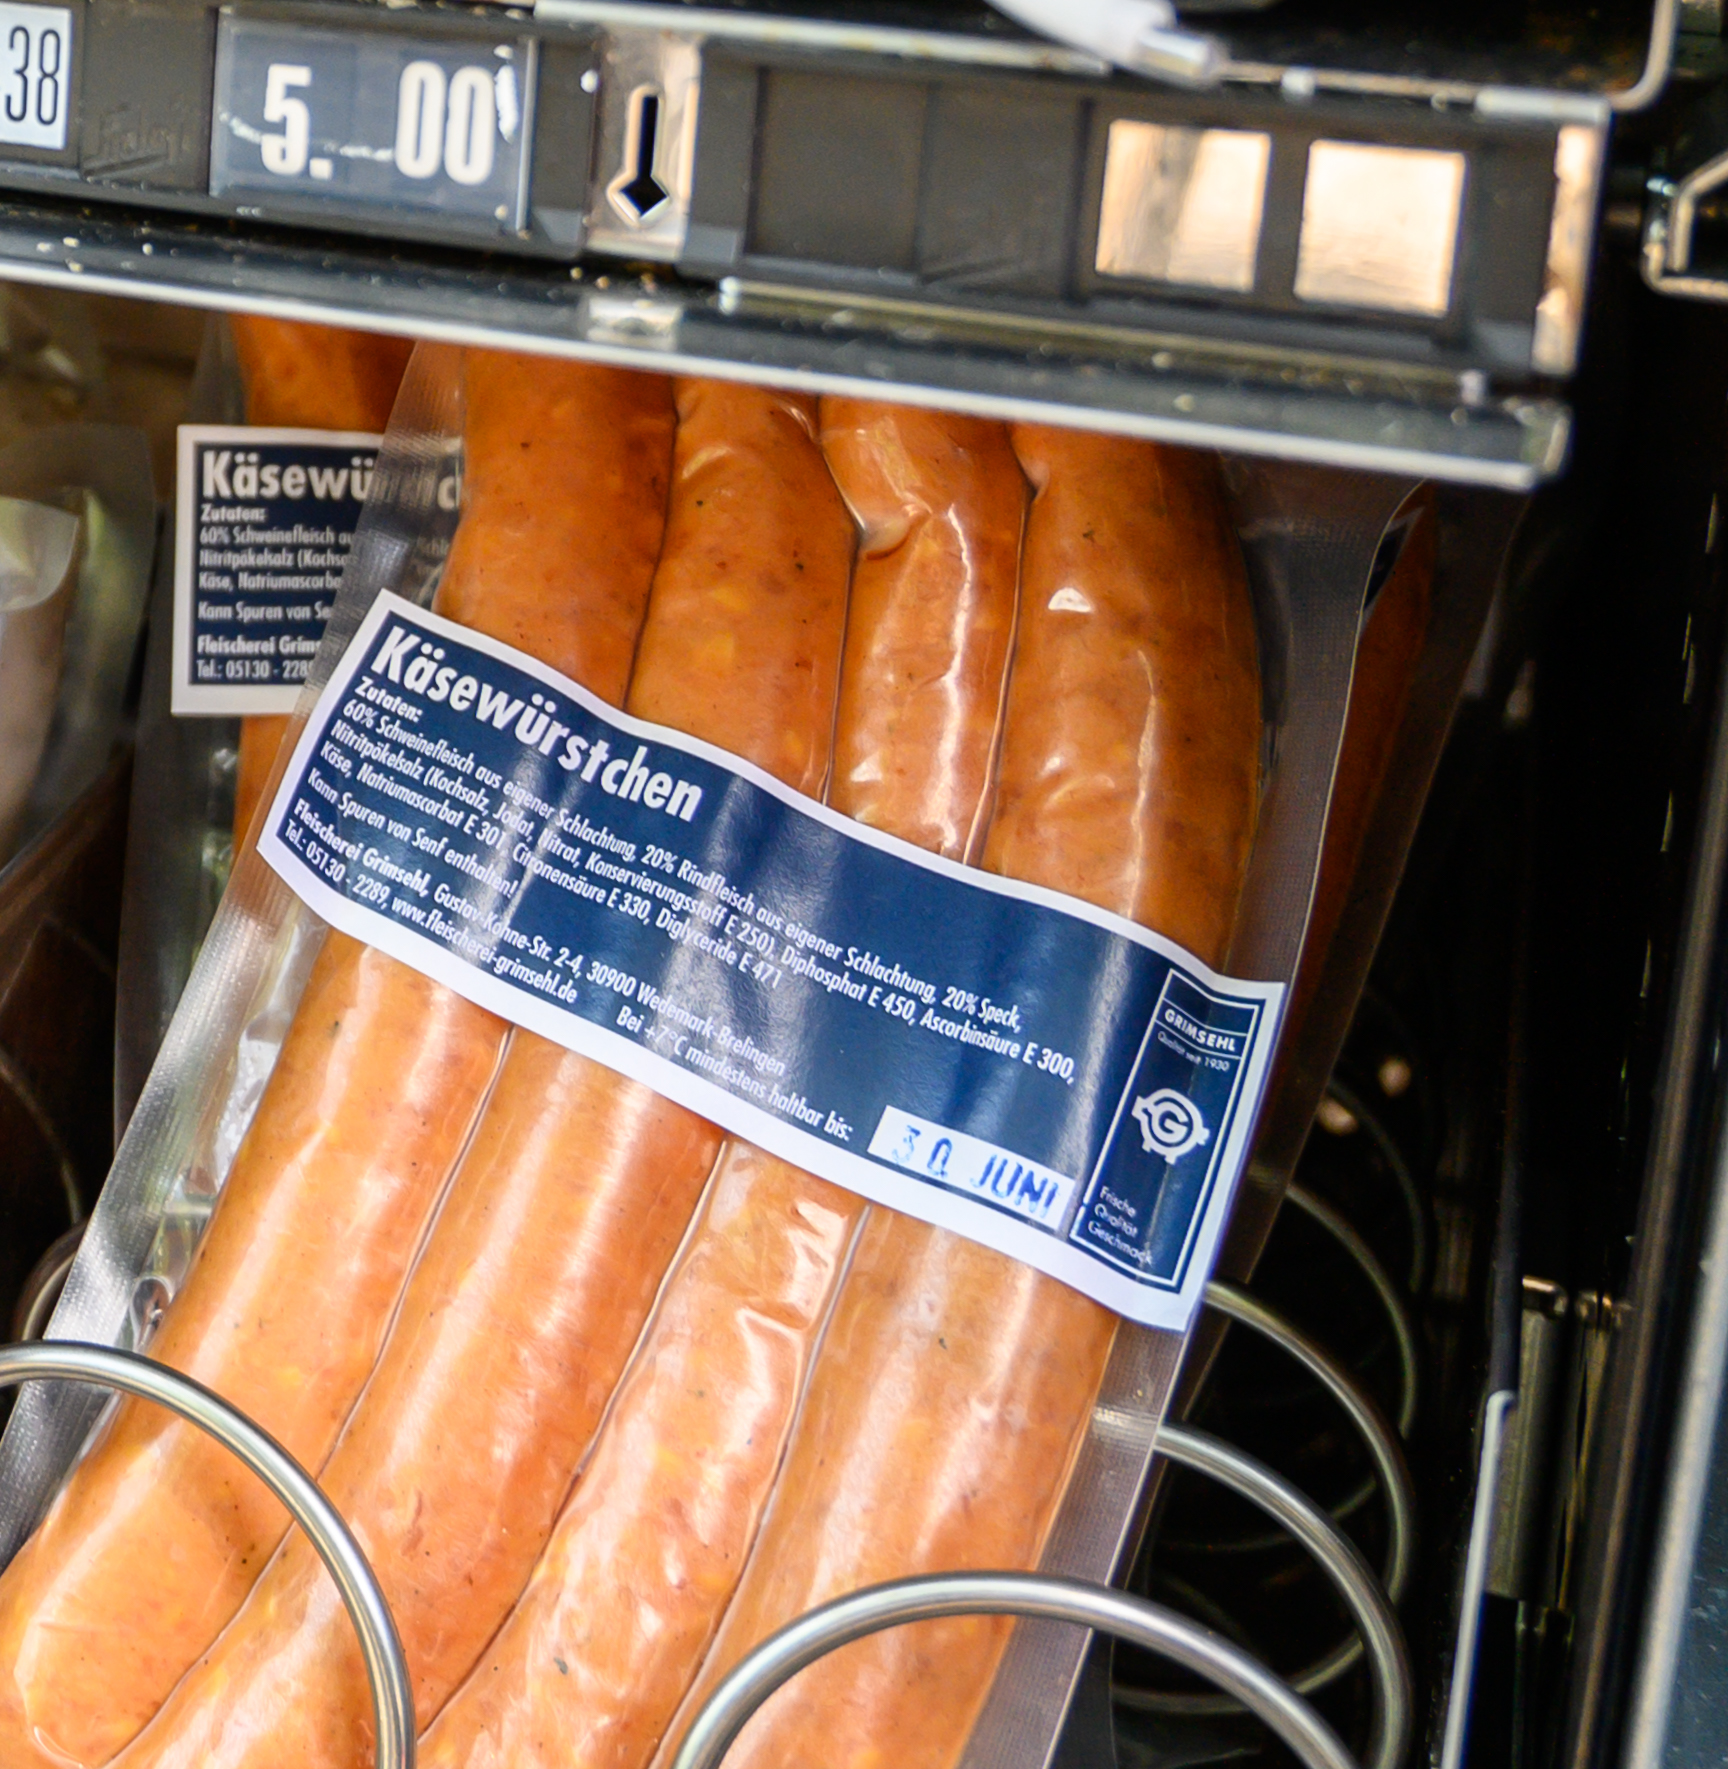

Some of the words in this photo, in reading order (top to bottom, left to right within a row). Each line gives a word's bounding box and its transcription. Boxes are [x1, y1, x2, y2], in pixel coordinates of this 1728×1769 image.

[394, 60, 497, 186] 00
[197, 635, 275, 654] Fleischerei
[225, 660, 269, 678] 05130
[354, 675, 423, 723] Zutaten:
[371, 625, 703, 822] Käsewürstchen
[306, 768, 337, 804] Kann
[341, 792, 394, 830] Spuren
[387, 815, 412, 842] von
[412, 827, 450, 860] Senf
[320, 741, 353, 778] Käse,
[357, 763, 465, 827] Natriumascorbat
[512, 842, 605, 904] Citronensäure
[606, 887, 621, 908] E
[618, 892, 651, 926] 330,
[655, 908, 736, 966] Diglyceride
[738, 953, 753, 973] E
[751, 960, 783, 989] 471
[331, 719, 425, 780] Nitritpökelsalz
[423, 765, 490, 816] (Kochsalz,
[493, 801, 535, 841] Jodat,
[584, 852, 726, 925] Konservierungsstoff
[781, 945, 867, 1002] Diphosphat
[868, 987, 882, 1007] E
[882, 994, 916, 1027] 450,
[920, 1009, 1021, 1058] Ascorbinsäure
[1023, 1042, 1038, 1064] E
[1036, 1048, 1075, 1084] 300,
[342, 698, 377, 728] 60%
[376, 713, 474, 775] Schweinefleisch
[475, 766, 503, 788] aus
[503, 782, 556, 820] eigener
[556, 808, 637, 862] Schlachtung,
[641, 844, 678, 874] 20%
[677, 860, 756, 916] Rindfleisch
[756, 907, 785, 932] aus
[784, 922, 843, 961] eigener
[844, 946, 937, 1004] Schlachtung,
[942, 986, 977, 1015] 20%
[977, 998, 1022, 1033] Speck,
[294, 798, 365, 860] Fleischerei
[362, 844, 430, 898] Grimsehl,
[433, 882, 552, 960] Gustav-Kohne-Str.
[553, 947, 583, 979] 2-4,
[586, 961, 636, 996] 30900
[636, 982, 786, 1077] Wedemark-Brelingen
[284, 820, 307, 853] Tel.:
[305, 840, 345, 882] 05130
[352, 874, 388, 910] 2289,
[392, 894, 578, 1003] www.fleischerei-grimsehl.de
[617, 1004, 645, 1034] Bei
[684, 1043, 768, 1102] mindestens
[768, 1084, 823, 1128] haltbar
[823, 1110, 854, 1143] bis:
[1164, 1007, 1236, 1052] GRIMSEHL
[1204, 1057, 1230, 1072] 1930
[970, 1153, 1060, 1219] JUNI
[1099, 1186, 1137, 1218] Frische
[1088, 1221, 1154, 1265] Geschmack
